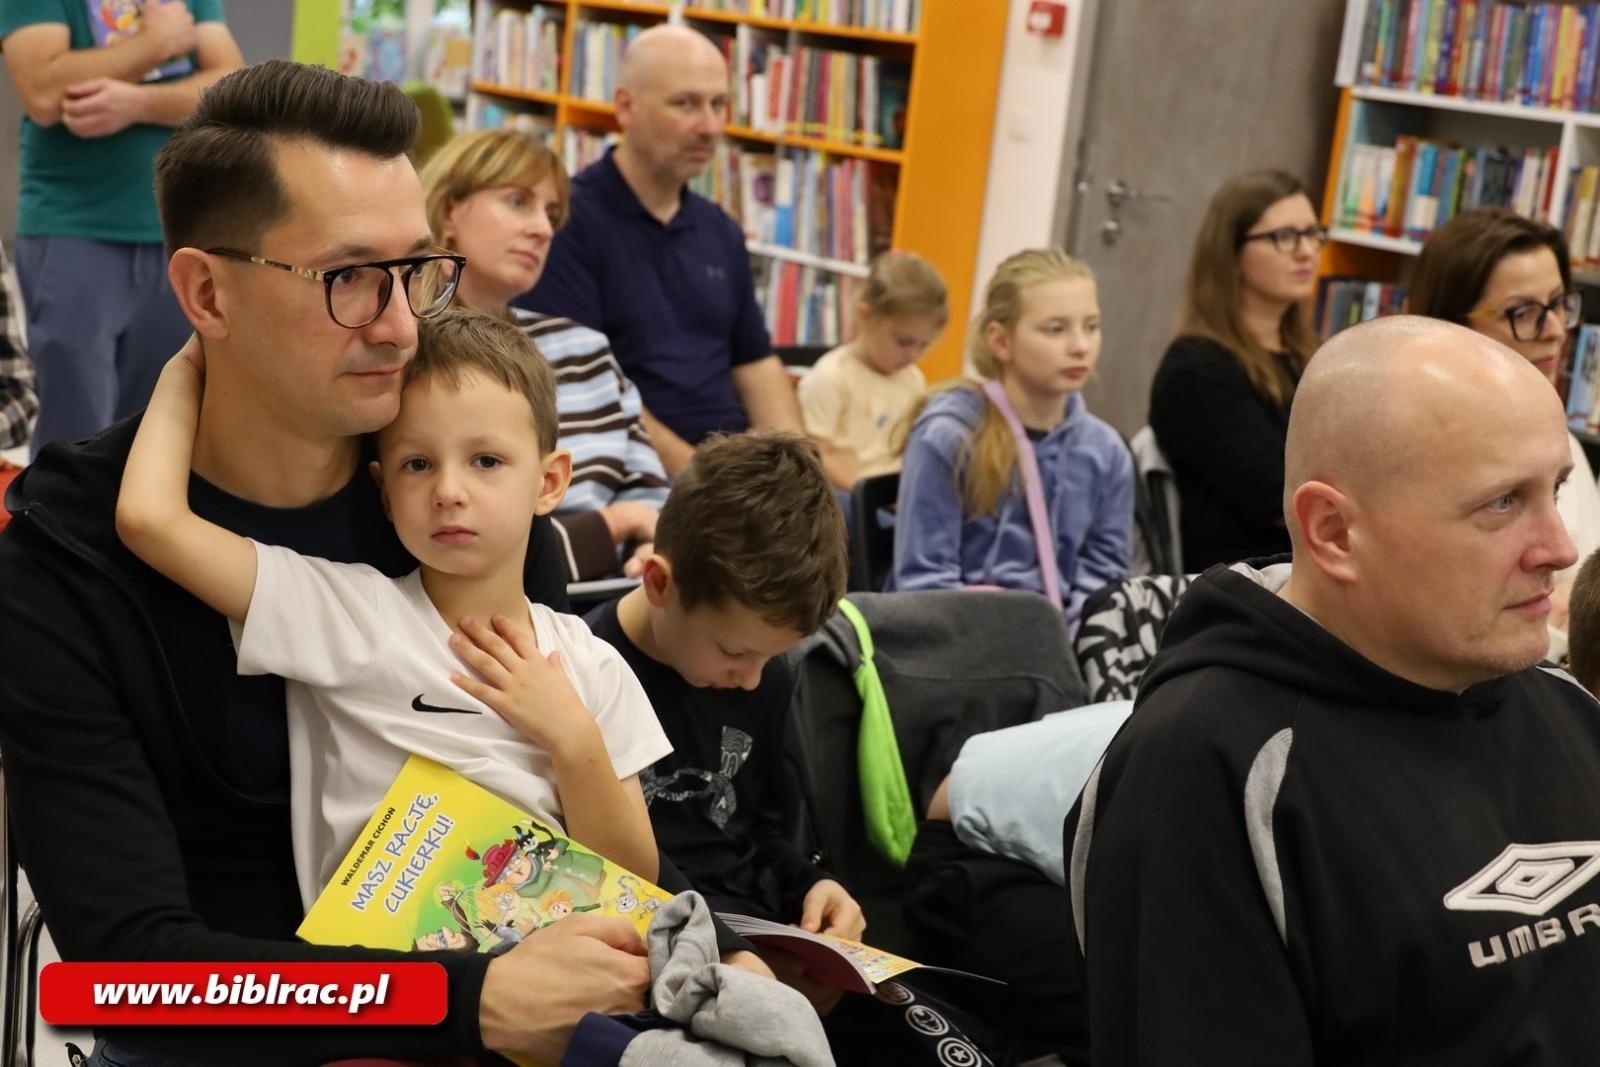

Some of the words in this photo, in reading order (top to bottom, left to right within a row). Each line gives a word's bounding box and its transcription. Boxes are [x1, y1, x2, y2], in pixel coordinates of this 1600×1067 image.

[341, 839, 375, 886] WALDEMAR
[372, 806, 396, 839] CICHOŃ
[351, 859, 393, 910] MASZ
[385, 793, 438, 857] RACJĘ,
[385, 814, 454, 913] CUKIERKU!
